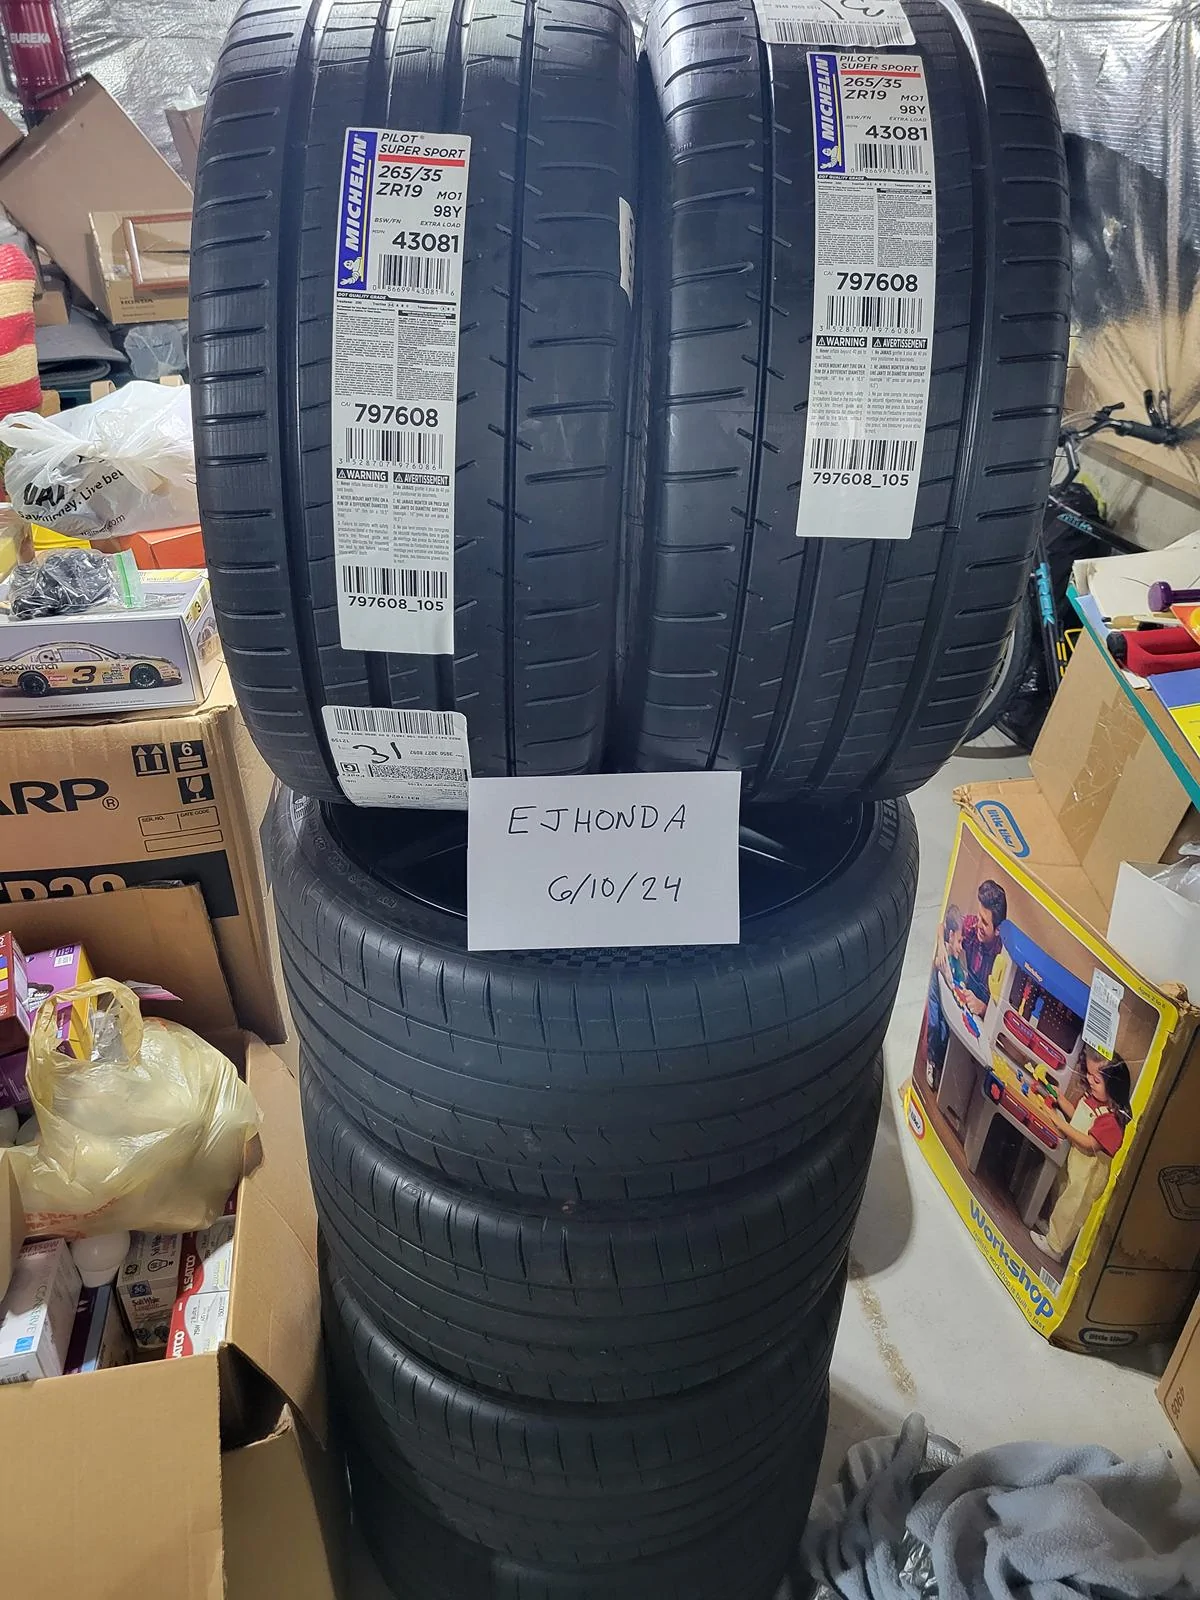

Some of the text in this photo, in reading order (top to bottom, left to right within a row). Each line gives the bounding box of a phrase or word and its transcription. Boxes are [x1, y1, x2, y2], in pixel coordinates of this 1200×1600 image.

[10, 32, 51, 44] EUREKA
[880, 64, 919, 72] SPORT
[843, 77, 902, 88] 265/35
[816, 57, 835, 142] MICHELIN
[844, 89, 887, 100] ZR19
[899, 105, 926, 115] 98Y
[865, 125, 928, 141] 43081
[380, 144, 466, 158] SUPER SPORT
[378, 165, 444, 182] 265/35
[345, 136, 368, 252] MICHELIN
[376, 182, 423, 198] ZR19
[436, 192, 462, 200] MO1
[433, 205, 463, 218] 98Y
[420, 220, 441, 228] EXTRA
[392, 231, 460, 253] 43081
[836, 272, 918, 292] 797608
[826, 336, 866, 347] WARNING
[882, 339, 926, 349] AVERTISSEMENT
[354, 403, 439, 428] 797608
[347, 469, 386, 481] WARNING
[404, 475, 449, 485] AVERTISSEMENT
[812, 472, 909, 488] 797608_105
[80, 481, 103, 501] Live
[1036, 561, 1055, 627] TREK
[348, 595, 444, 612] 797608_105
[72, 666, 96, 684] 3
[181, 742, 193, 756] 6
[548, 872, 682, 904] 6/10/24
[968, 1198, 1054, 1318] Workshop
[988, 1254, 1013, 1290] workshop
[1010, 1286, 1018, 1294] is
[1026, 1306, 1035, 1318] to
[1032, 1314, 1047, 1331] last
